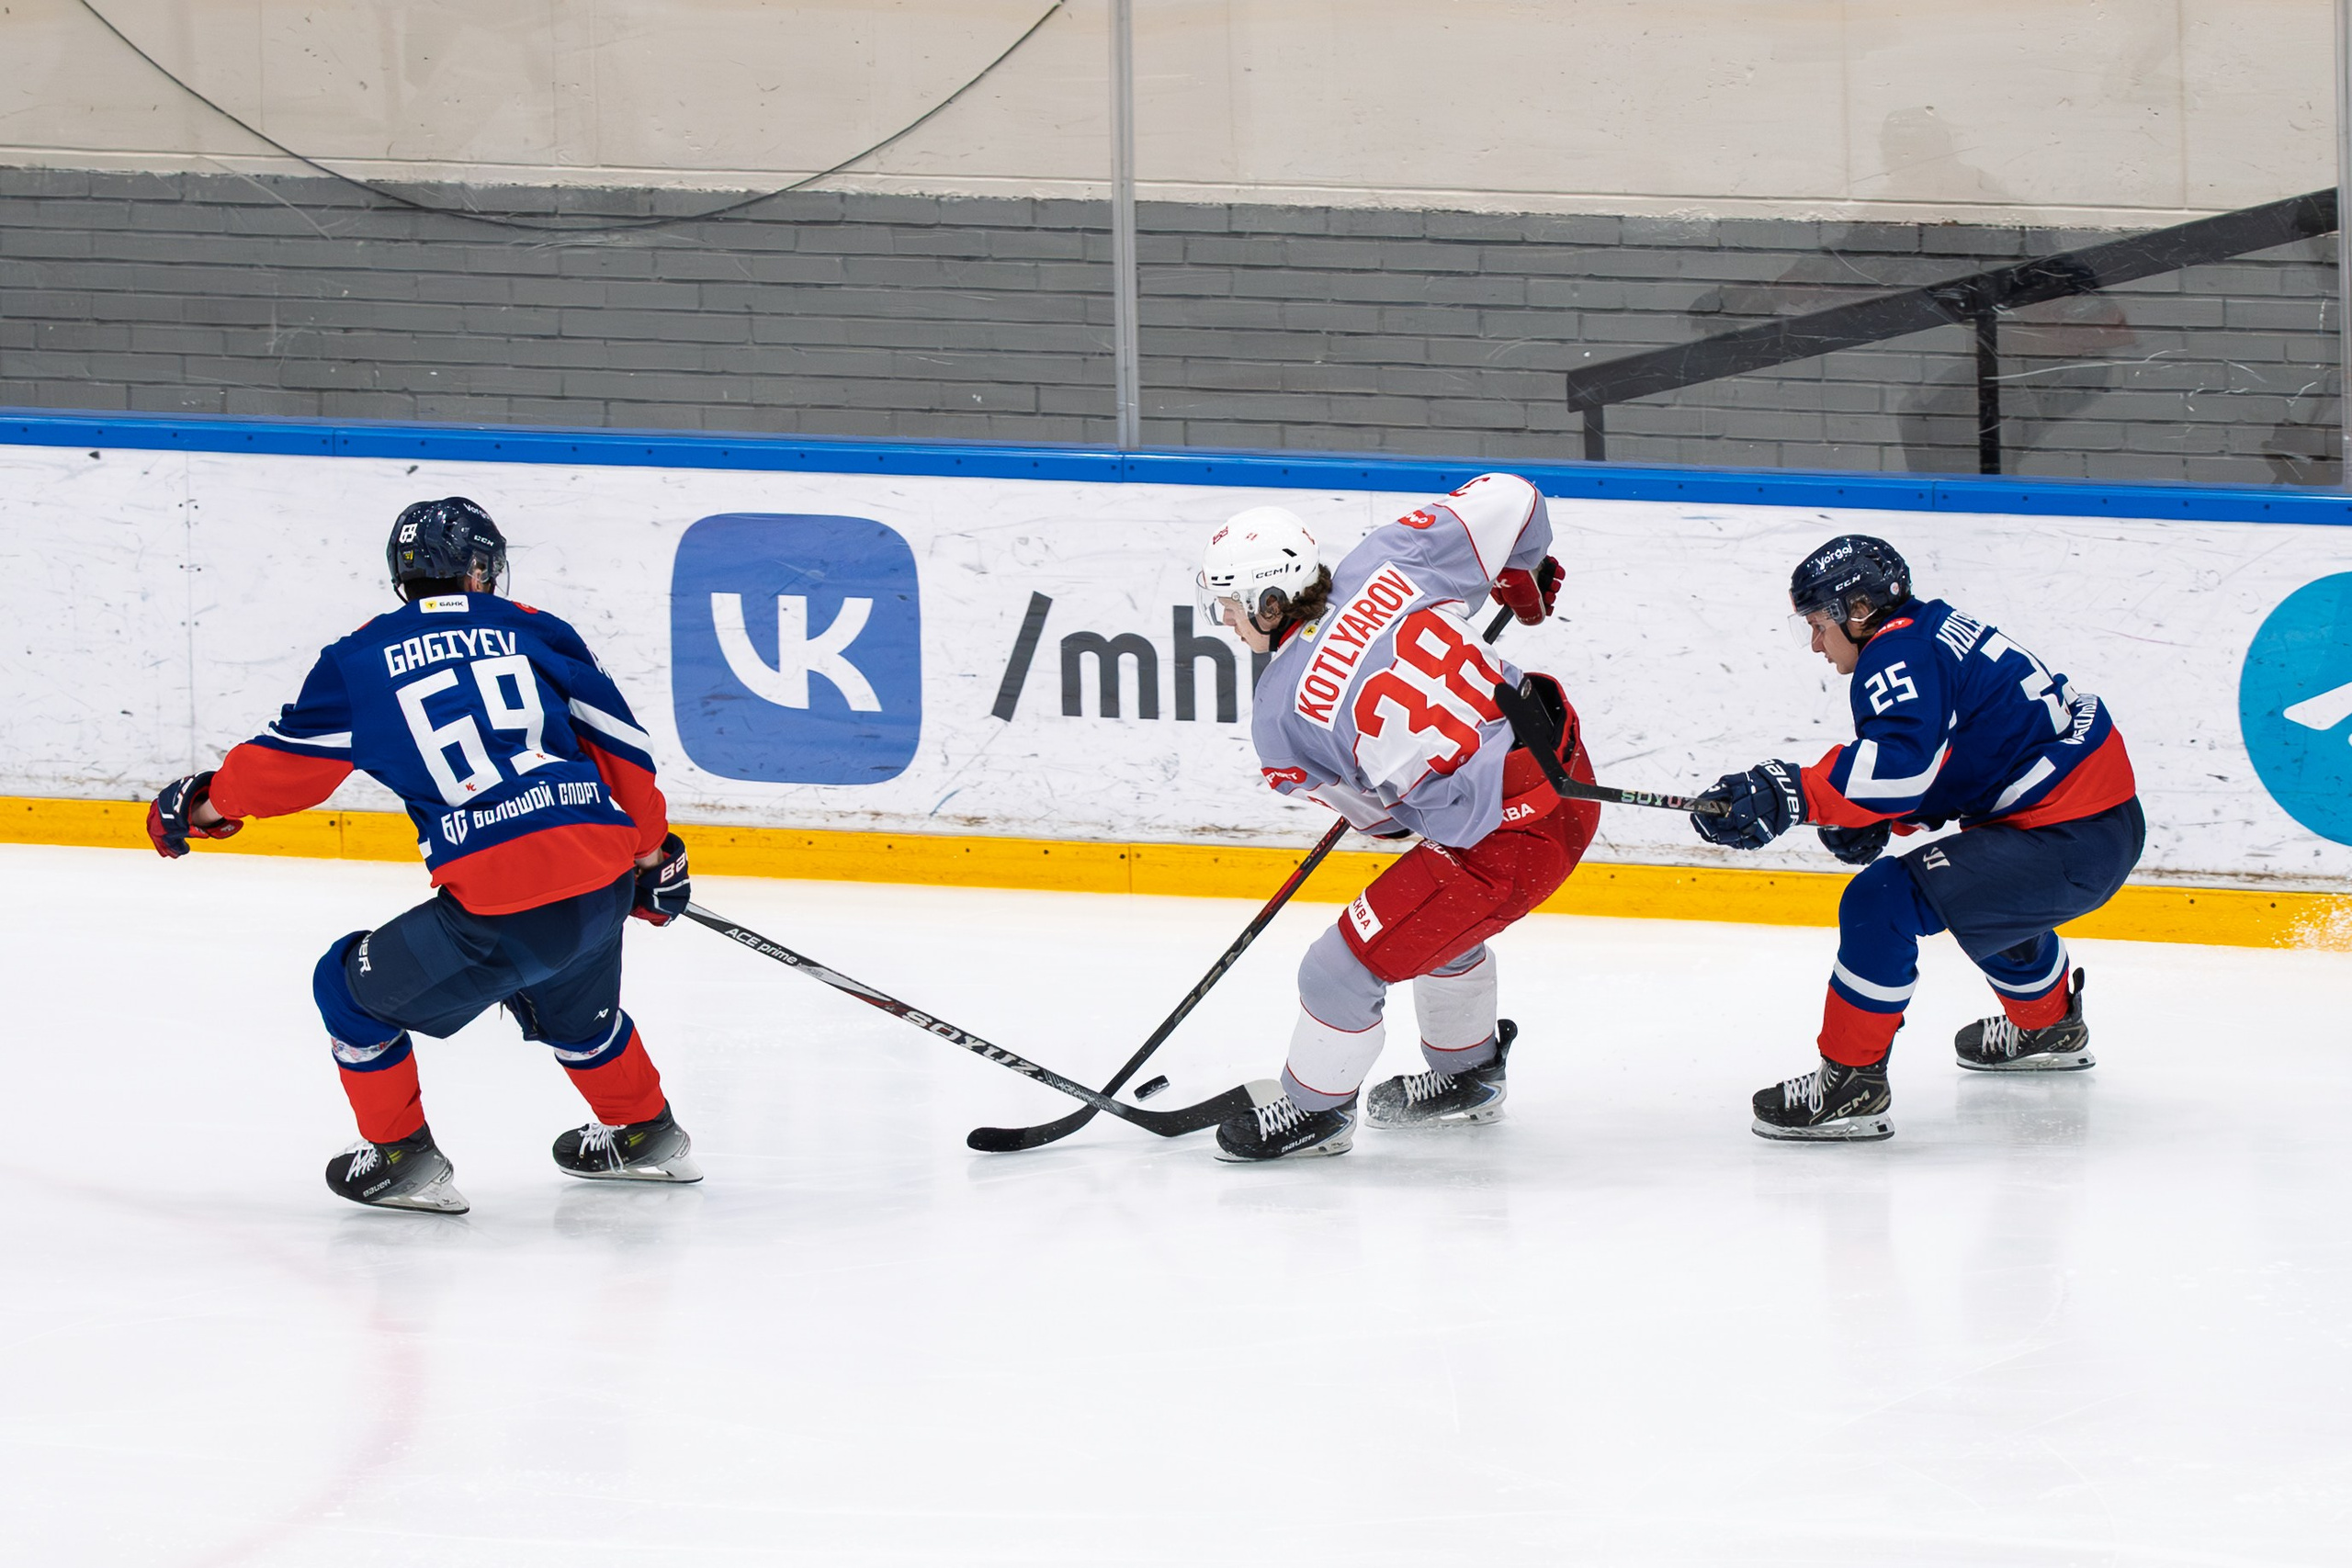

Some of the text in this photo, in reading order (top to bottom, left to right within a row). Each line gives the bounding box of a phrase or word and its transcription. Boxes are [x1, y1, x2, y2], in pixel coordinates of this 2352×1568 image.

[473, 535, 494, 547] CCM
[1255, 567, 1283, 580] CCM
[1835, 574, 1861, 592] CCM
[383, 628, 516, 679] GAGIYEV
[710, 592, 883, 712] VK
[1297, 569, 1415, 724] KOTLYAROV
[1354, 608, 1507, 774] 38
[1864, 660, 1919, 716] 25
[395, 654, 568, 807] 69
[558, 782, 602, 806] СПОРТ
[1620, 790, 1696, 811] SOYUZ
[724, 928, 797, 965] ACE prime
[900, 1010, 1041, 1077] SOYUZ
[362, 1179, 392, 1198] BAUER
